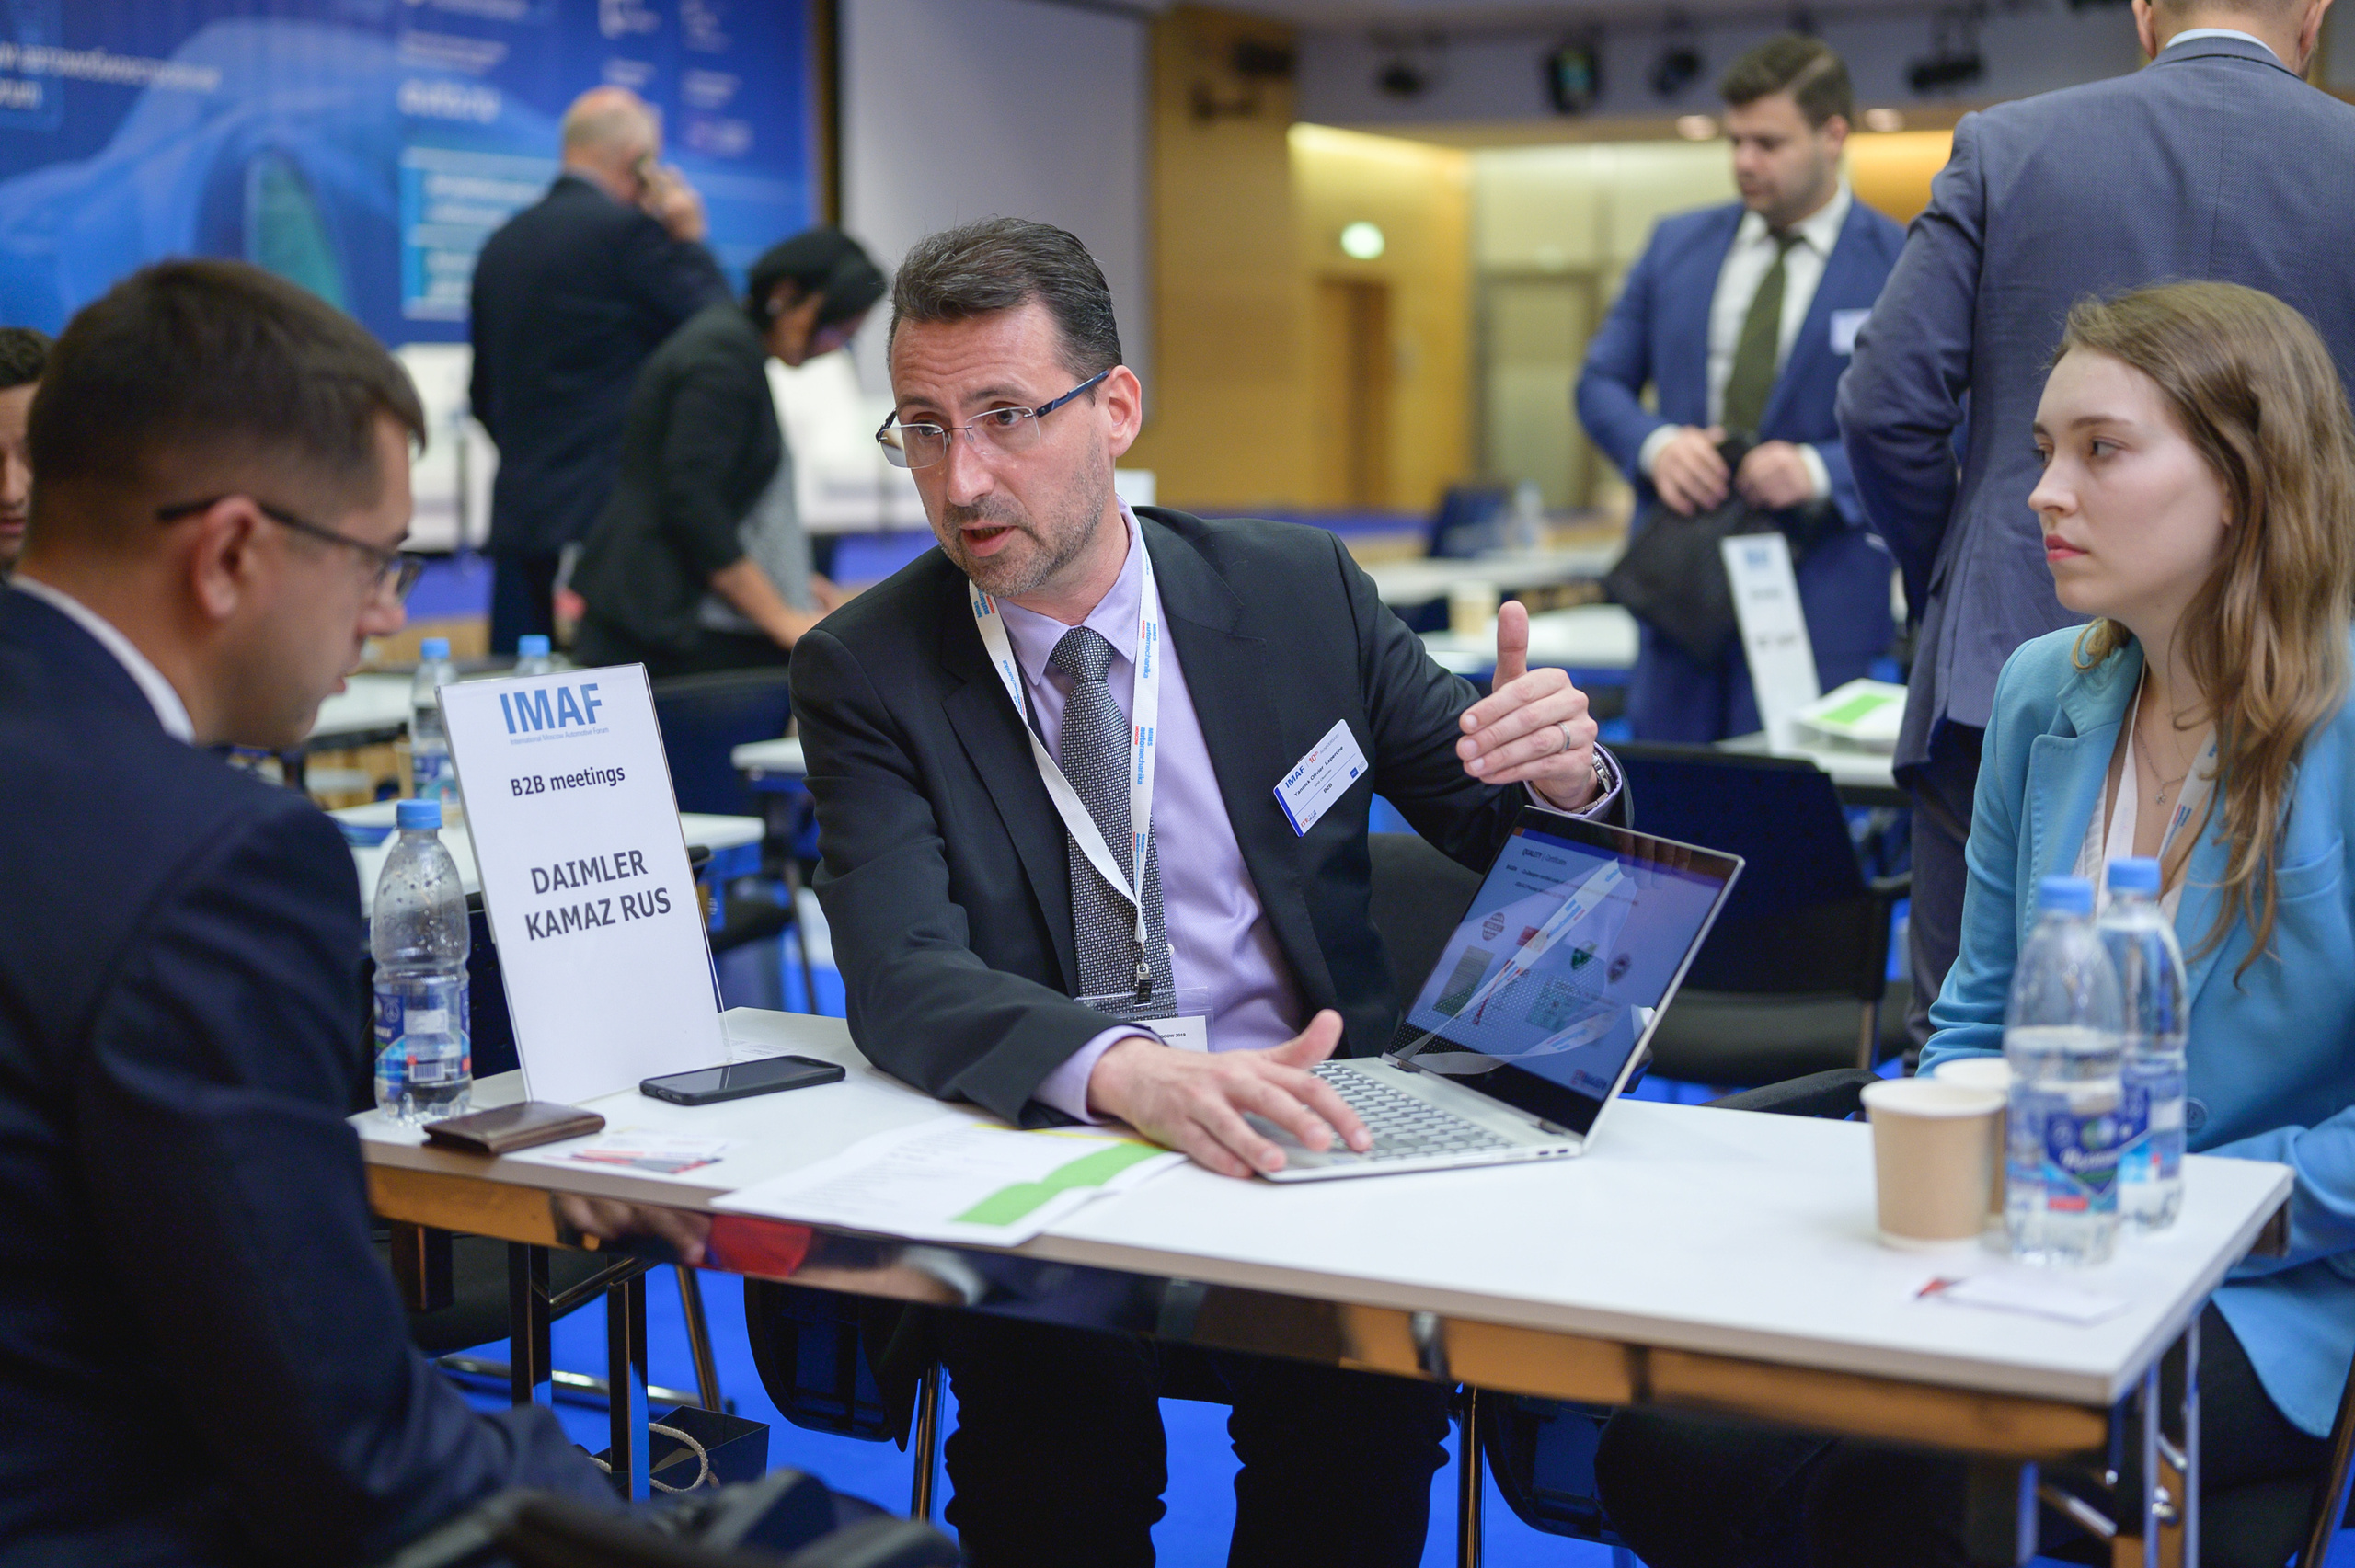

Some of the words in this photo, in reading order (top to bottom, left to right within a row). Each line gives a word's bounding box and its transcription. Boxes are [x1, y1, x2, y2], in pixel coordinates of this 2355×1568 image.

[500, 683, 602, 734] IMAF
[511, 735, 542, 745] International
[542, 733, 564, 741] Moscow
[565, 730, 593, 738] Automotive
[593, 727, 609, 735] Forum
[1137, 726, 1146, 785] automechanika
[511, 775, 545, 797] B2B
[550, 767, 626, 791] meetings
[1285, 765, 1305, 789] IMAF
[1294, 780, 1311, 797] Yannick
[1310, 766, 1324, 781] Olivier
[1324, 746, 1344, 766] Laperche
[1323, 783, 1333, 794] B2B
[530, 849, 649, 894] DAIMLER
[525, 898, 616, 940] KAMAZ
[619, 887, 671, 921] RUS
